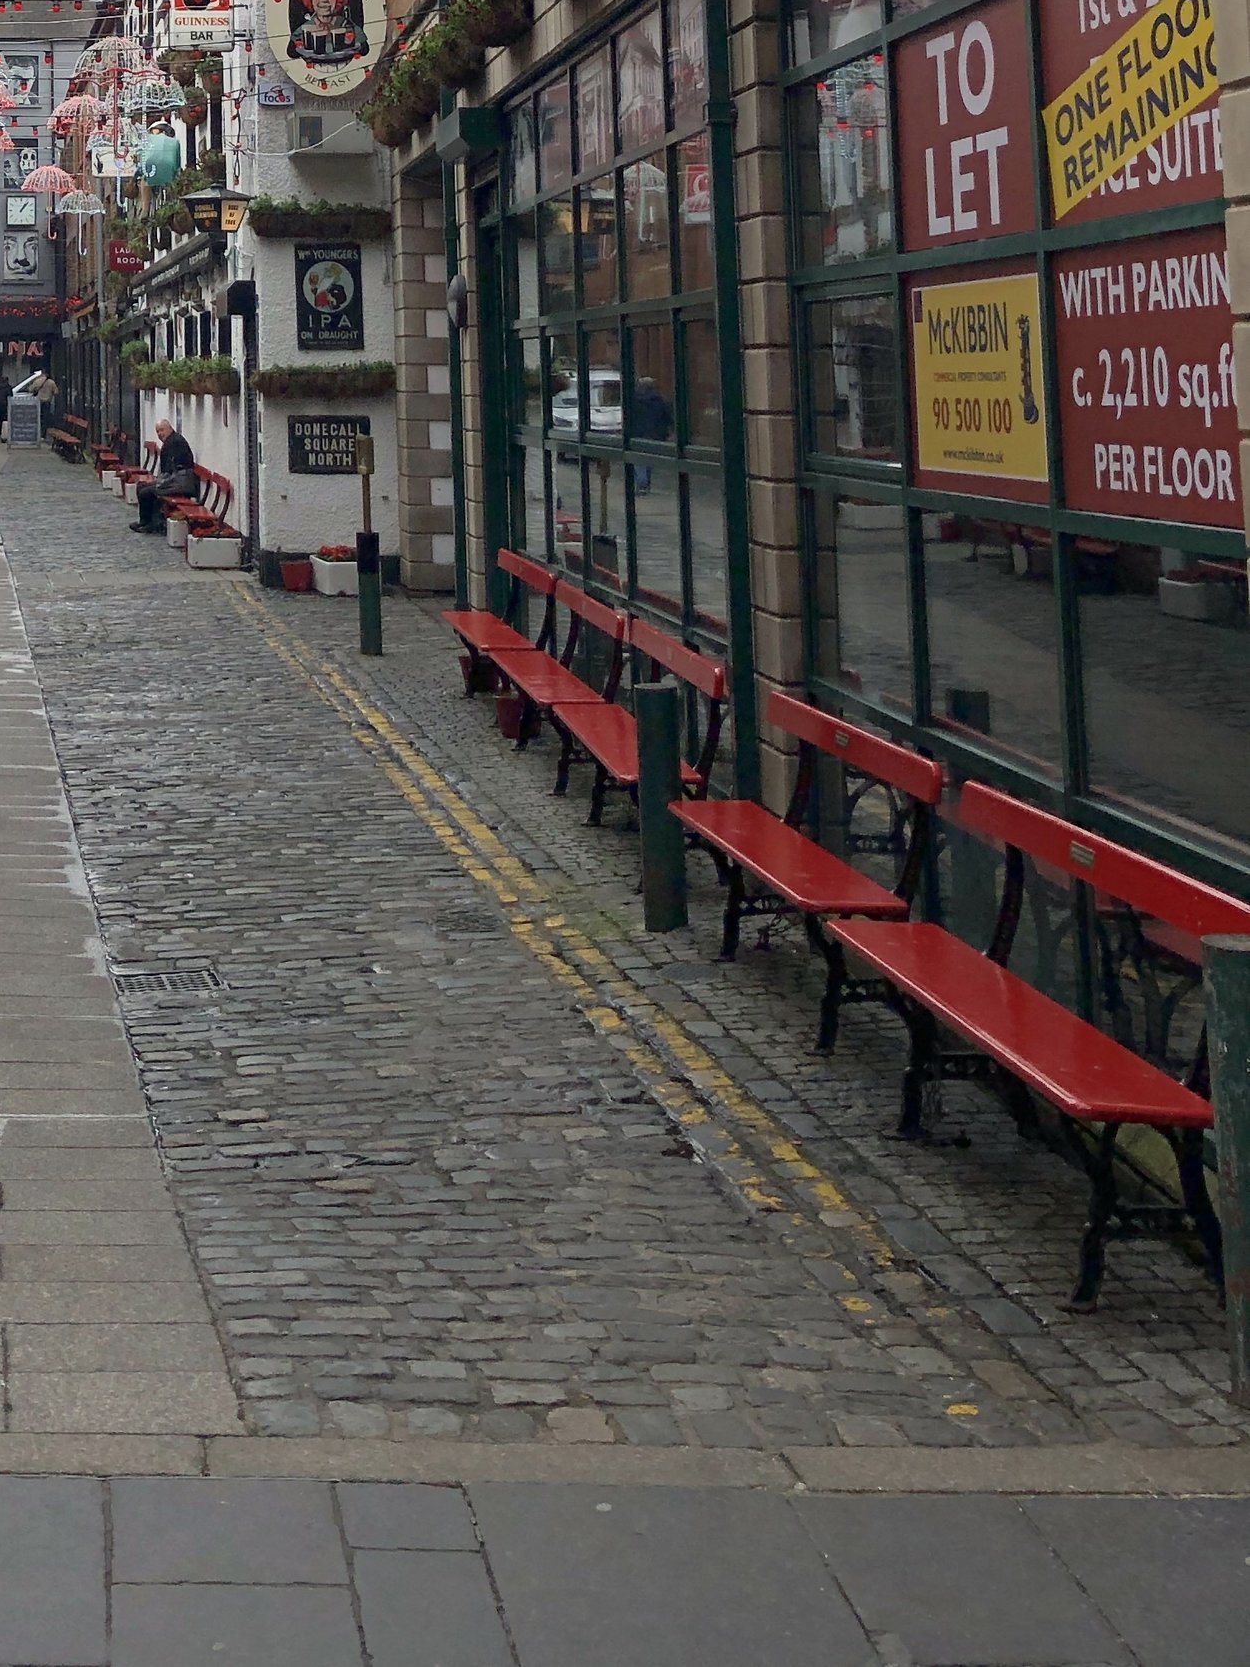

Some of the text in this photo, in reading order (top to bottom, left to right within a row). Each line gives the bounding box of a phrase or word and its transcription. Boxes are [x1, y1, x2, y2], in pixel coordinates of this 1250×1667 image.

[174, 17, 230, 26] GUINNESS
[190, 31, 214, 41] BAR
[304, 73, 351, 88] BELAST
[926, 20, 995, 126] TO
[264, 92, 291, 103] focs
[1055, 66, 1113, 146] ONE
[925, 126, 1009, 236] LET
[1059, 264, 1126, 318] WITH
[300, 330, 359, 340] ON DRAUGHT
[928, 302, 1009, 355] McKIBBIN
[1099, 345, 1169, 420] 2,210
[933, 397, 1012, 434] 90 500 100
[304, 438, 356, 451] SQUARE
[308, 452, 352, 466] NORTH
[1094, 443, 1235, 502] PER FLOOR
